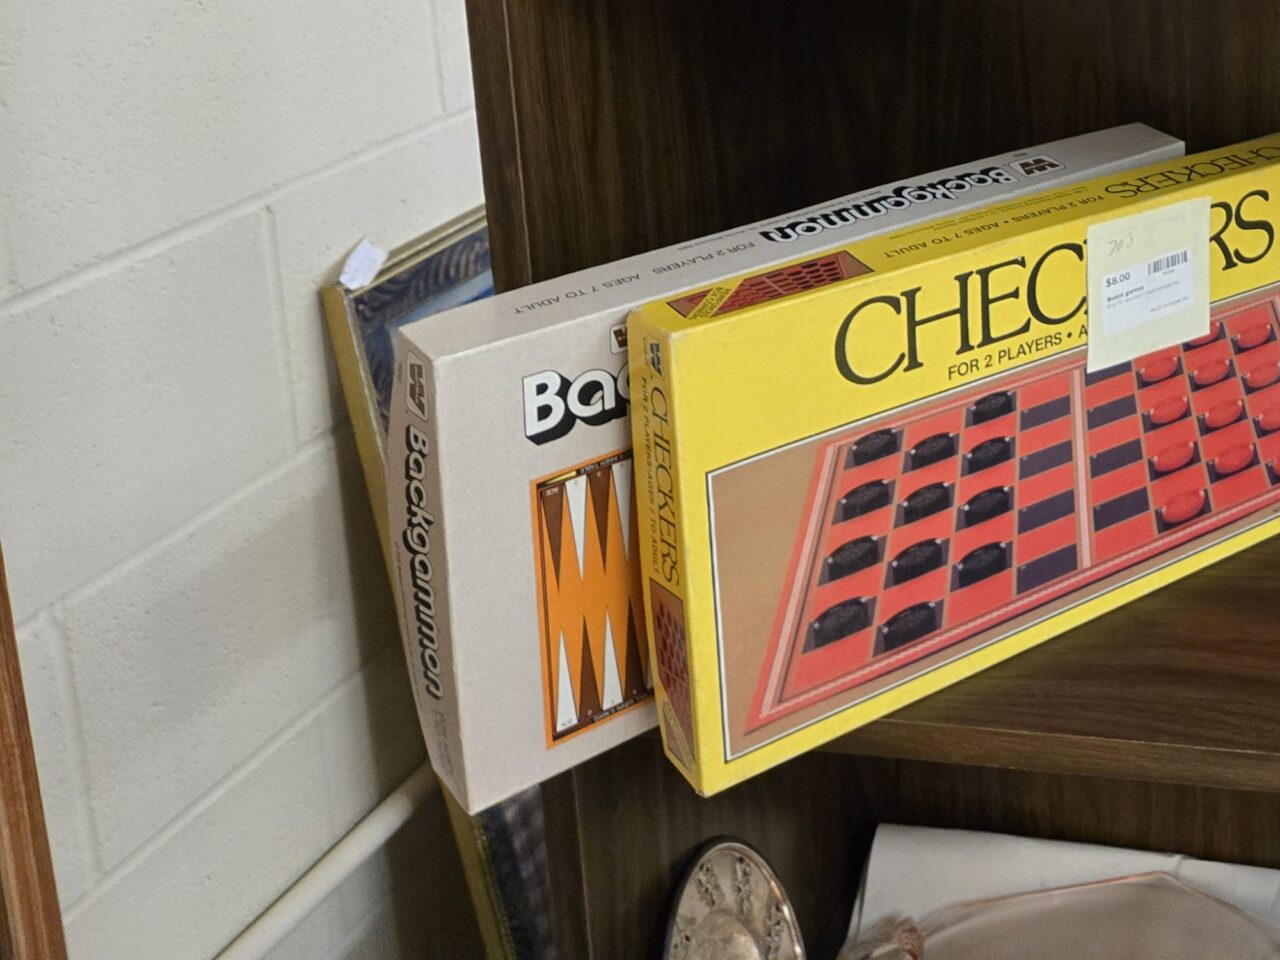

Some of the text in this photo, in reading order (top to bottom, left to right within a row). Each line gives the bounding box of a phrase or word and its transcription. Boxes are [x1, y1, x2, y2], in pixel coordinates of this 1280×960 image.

[760, 166, 1019, 243] Backgammon
[1069, 200, 1078, 208] 2
[1081, 194, 1104, 206] FOR
[1014, 203, 1068, 223] PLAYERS
[963, 222, 999, 236] AGES
[727, 242, 755, 253] FOR
[931, 236, 953, 244] TO
[884, 242, 927, 258] ADULT
[652, 254, 714, 274] PLAYERS
[602, 273, 640, 288] AGES
[834, 189, 1275, 385] CHECRS
[1106, 272, 1130, 288] $8.00
[565, 289, 588, 299] TO
[1125, 286, 1144, 297] games
[514, 297, 560, 314] ADULT
[948, 358, 980, 381] FOR
[984, 354, 993, 369] 2
[998, 331, 1063, 364] PLAYERS
[651, 386, 680, 586] CHECKERS
[403, 424, 443, 701] Backgammon
